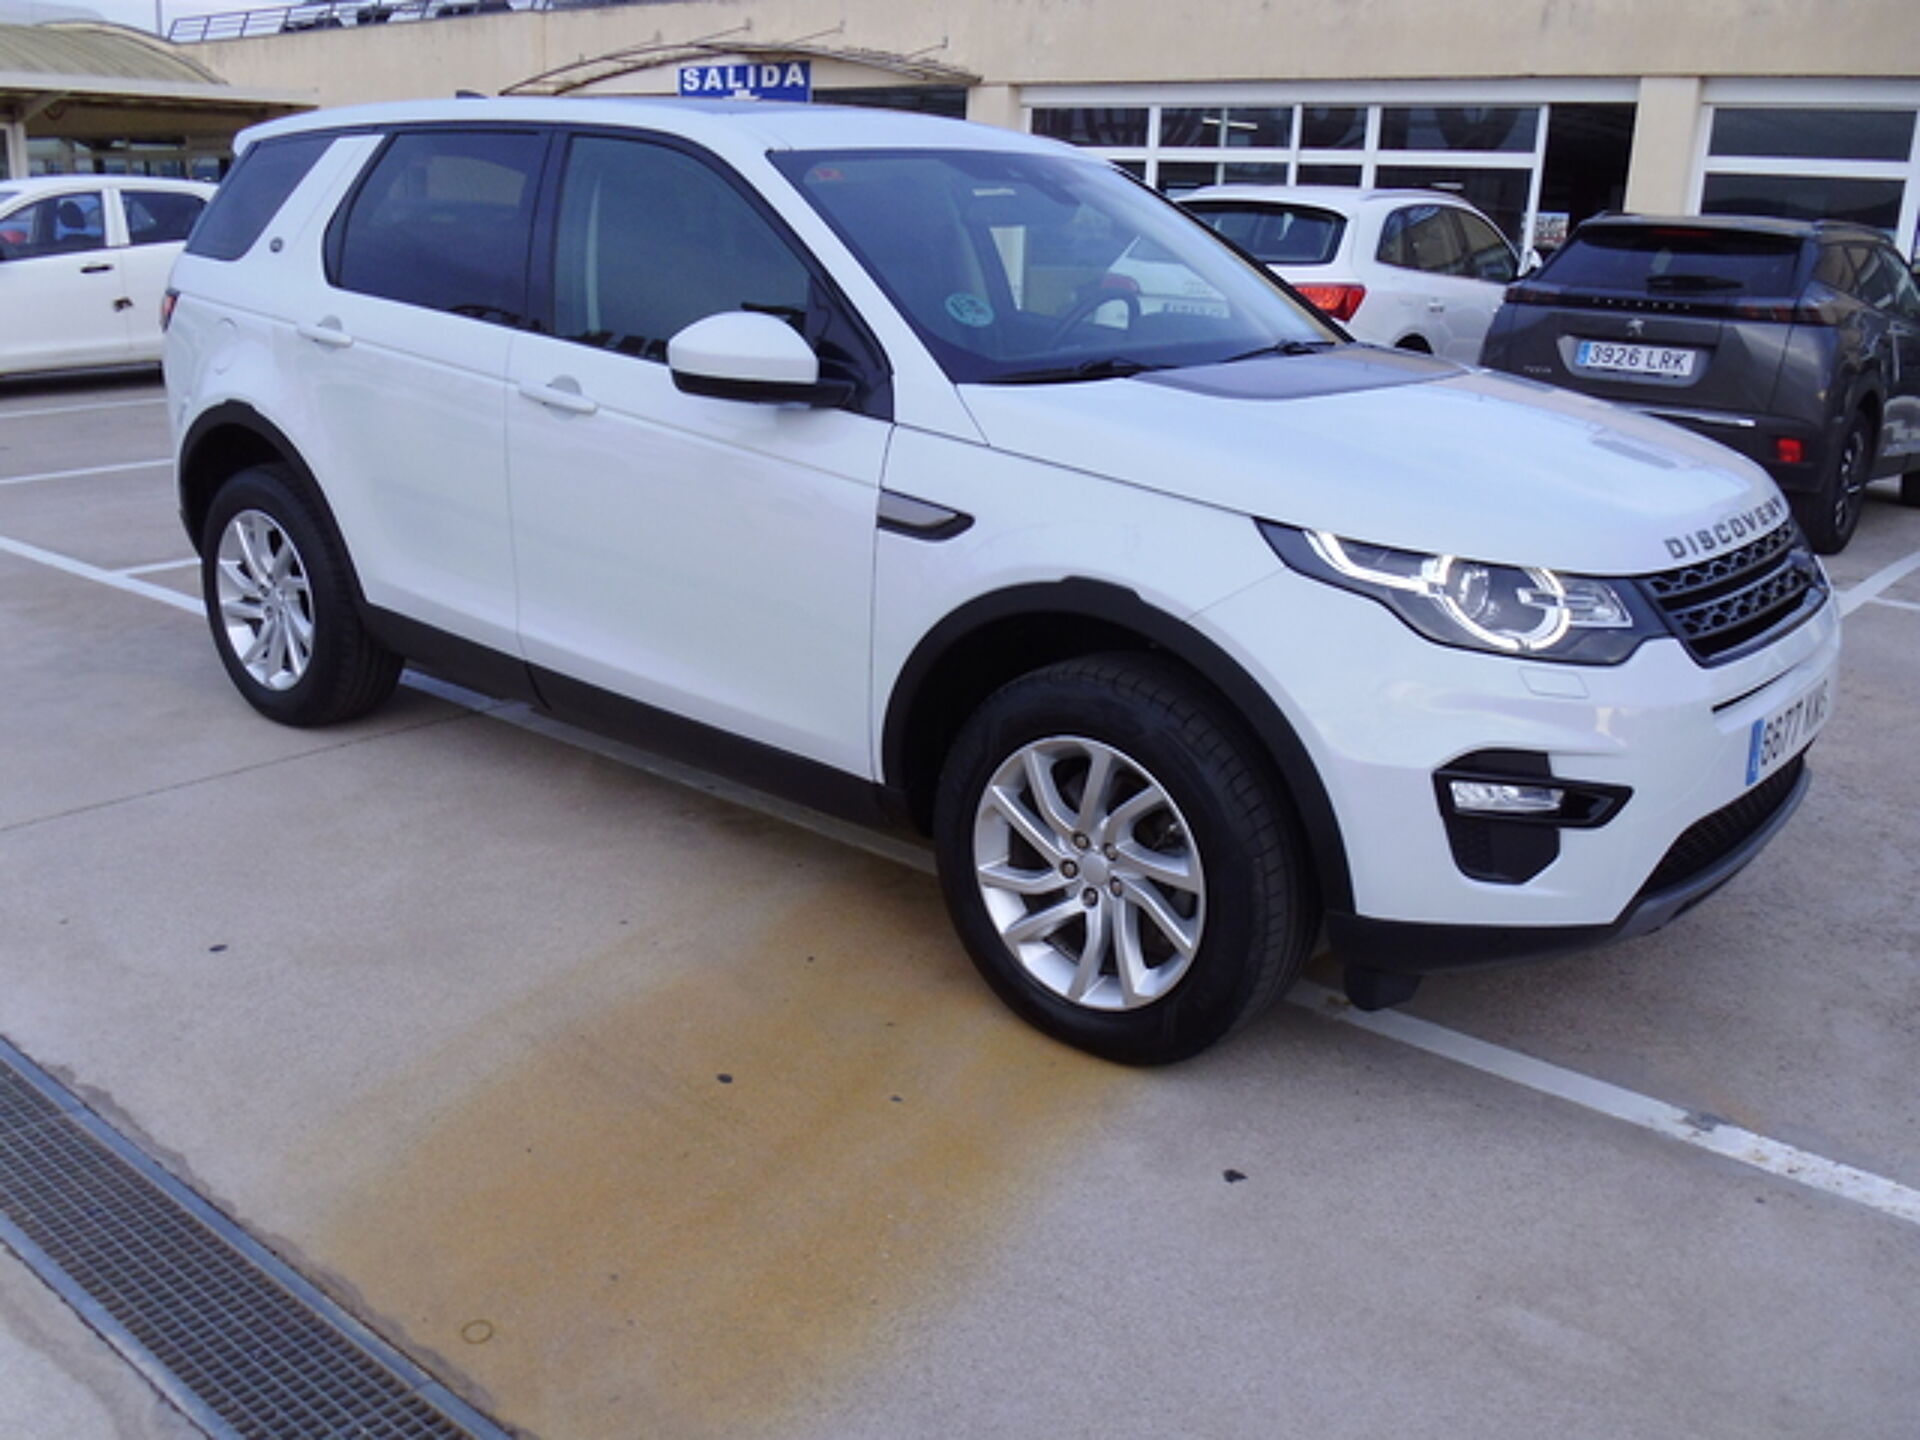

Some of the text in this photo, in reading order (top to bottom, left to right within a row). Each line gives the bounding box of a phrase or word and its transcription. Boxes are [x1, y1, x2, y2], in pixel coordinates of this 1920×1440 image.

[683, 62, 805, 91] SALIDA
[1590, 344, 1688, 372] 3926 LRK
[1663, 494, 1784, 560] DISCOVERY
